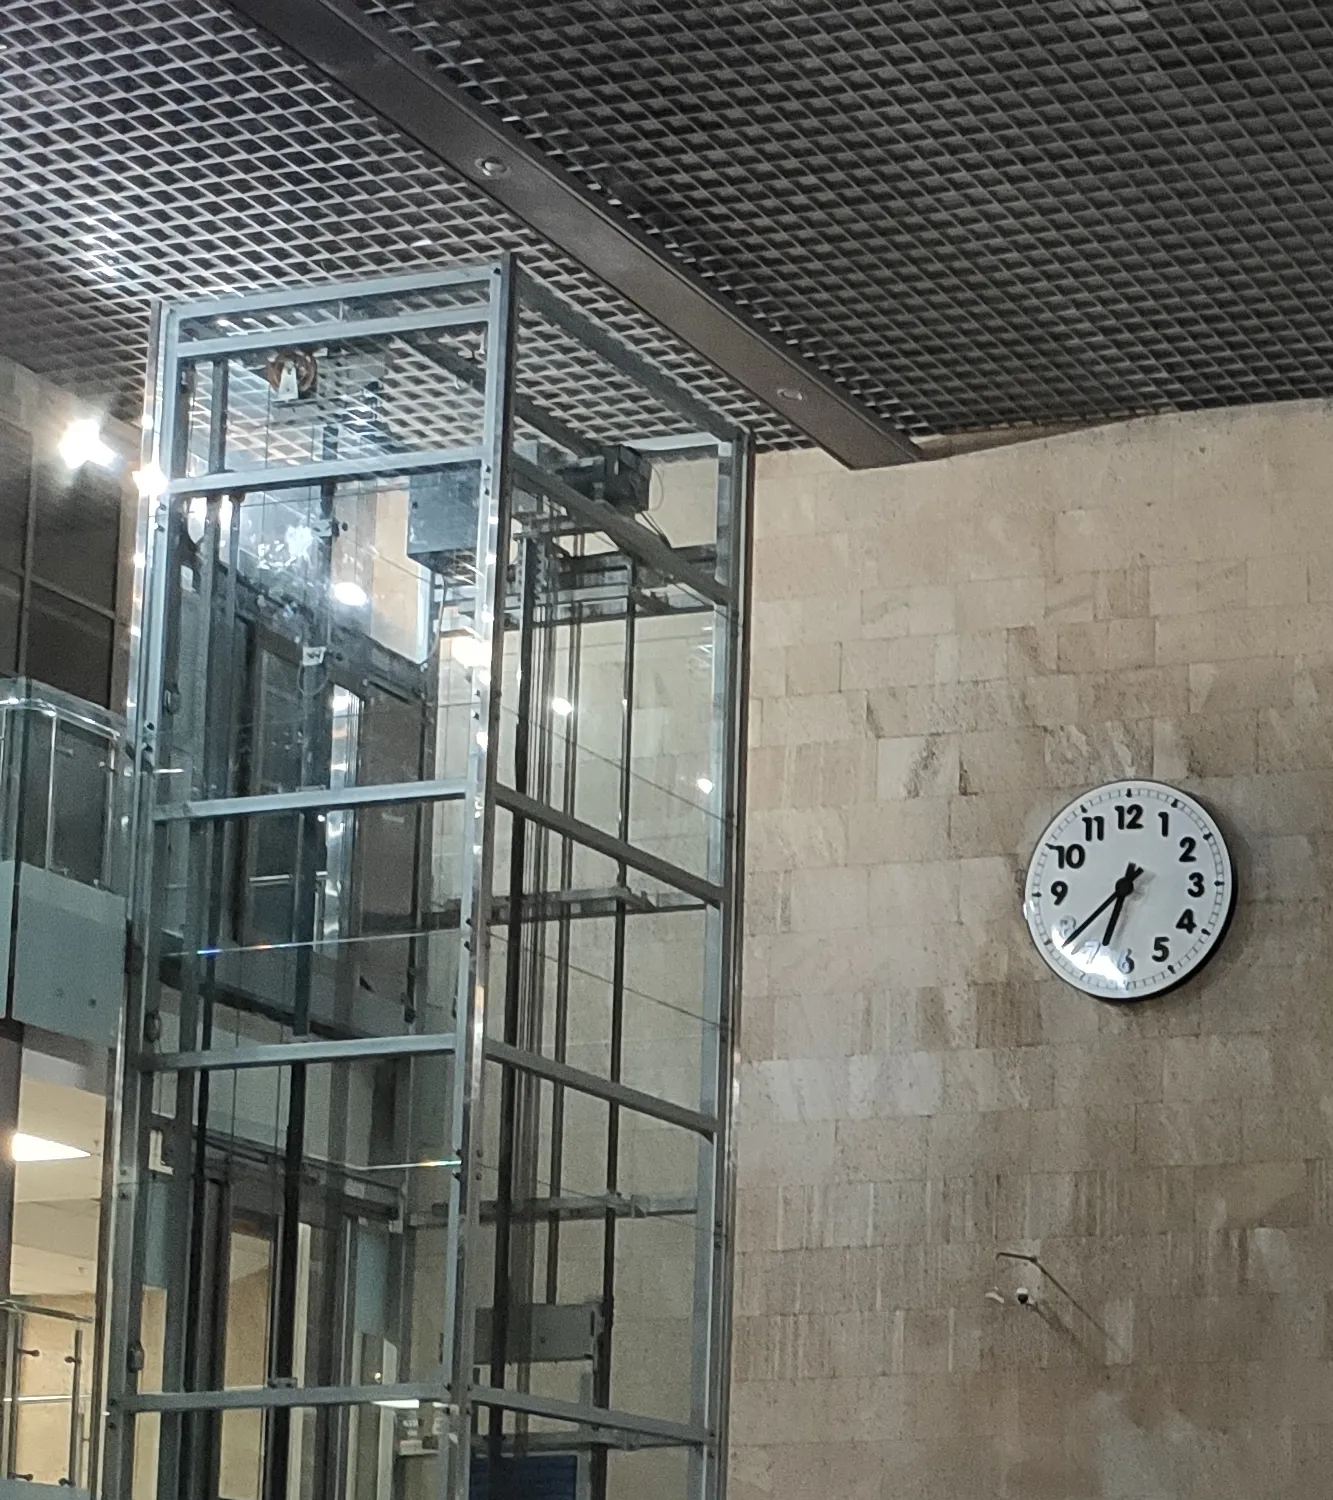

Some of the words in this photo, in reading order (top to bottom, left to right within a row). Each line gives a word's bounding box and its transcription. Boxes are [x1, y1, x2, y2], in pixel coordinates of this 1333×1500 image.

[1082, 815, 1104, 841] 11
[1115, 804, 1143, 830] 12
[1159, 812, 1169, 837] 1
[1057, 844, 1085, 869] 10
[1179, 837, 1196, 862] 2
[1051, 881, 1068, 905] 9
[1188, 872, 1204, 897] 3
[1176, 909, 1197, 934] 4
[1119, 949, 1135, 974] 6
[1152, 937, 1169, 961] 5
